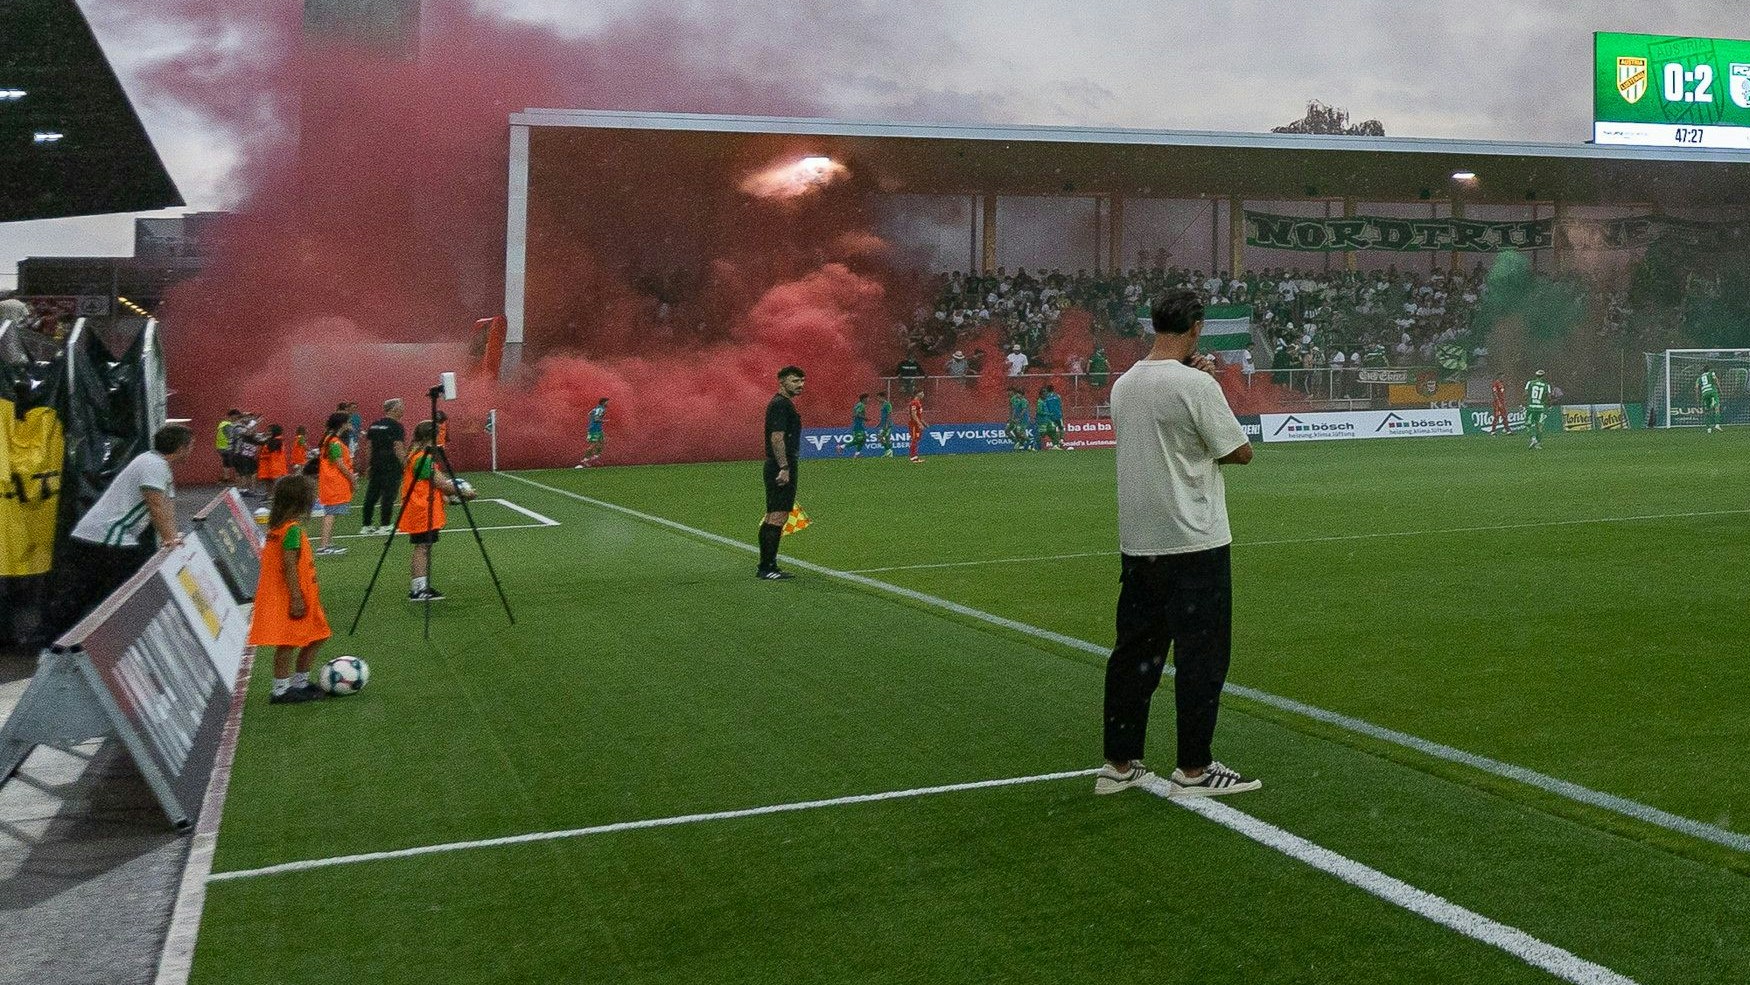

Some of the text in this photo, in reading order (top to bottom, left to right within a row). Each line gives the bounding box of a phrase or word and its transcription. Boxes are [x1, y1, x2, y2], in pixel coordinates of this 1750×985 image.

[1664, 63, 1713, 102] 0:2
[1675, 128, 1703, 143] 47:27
[1531, 386, 1544, 399] 61
[1670, 407, 1703, 415] SUN
[1311, 423, 1354, 431] bösch
[1412, 419, 1452, 427] bösch
